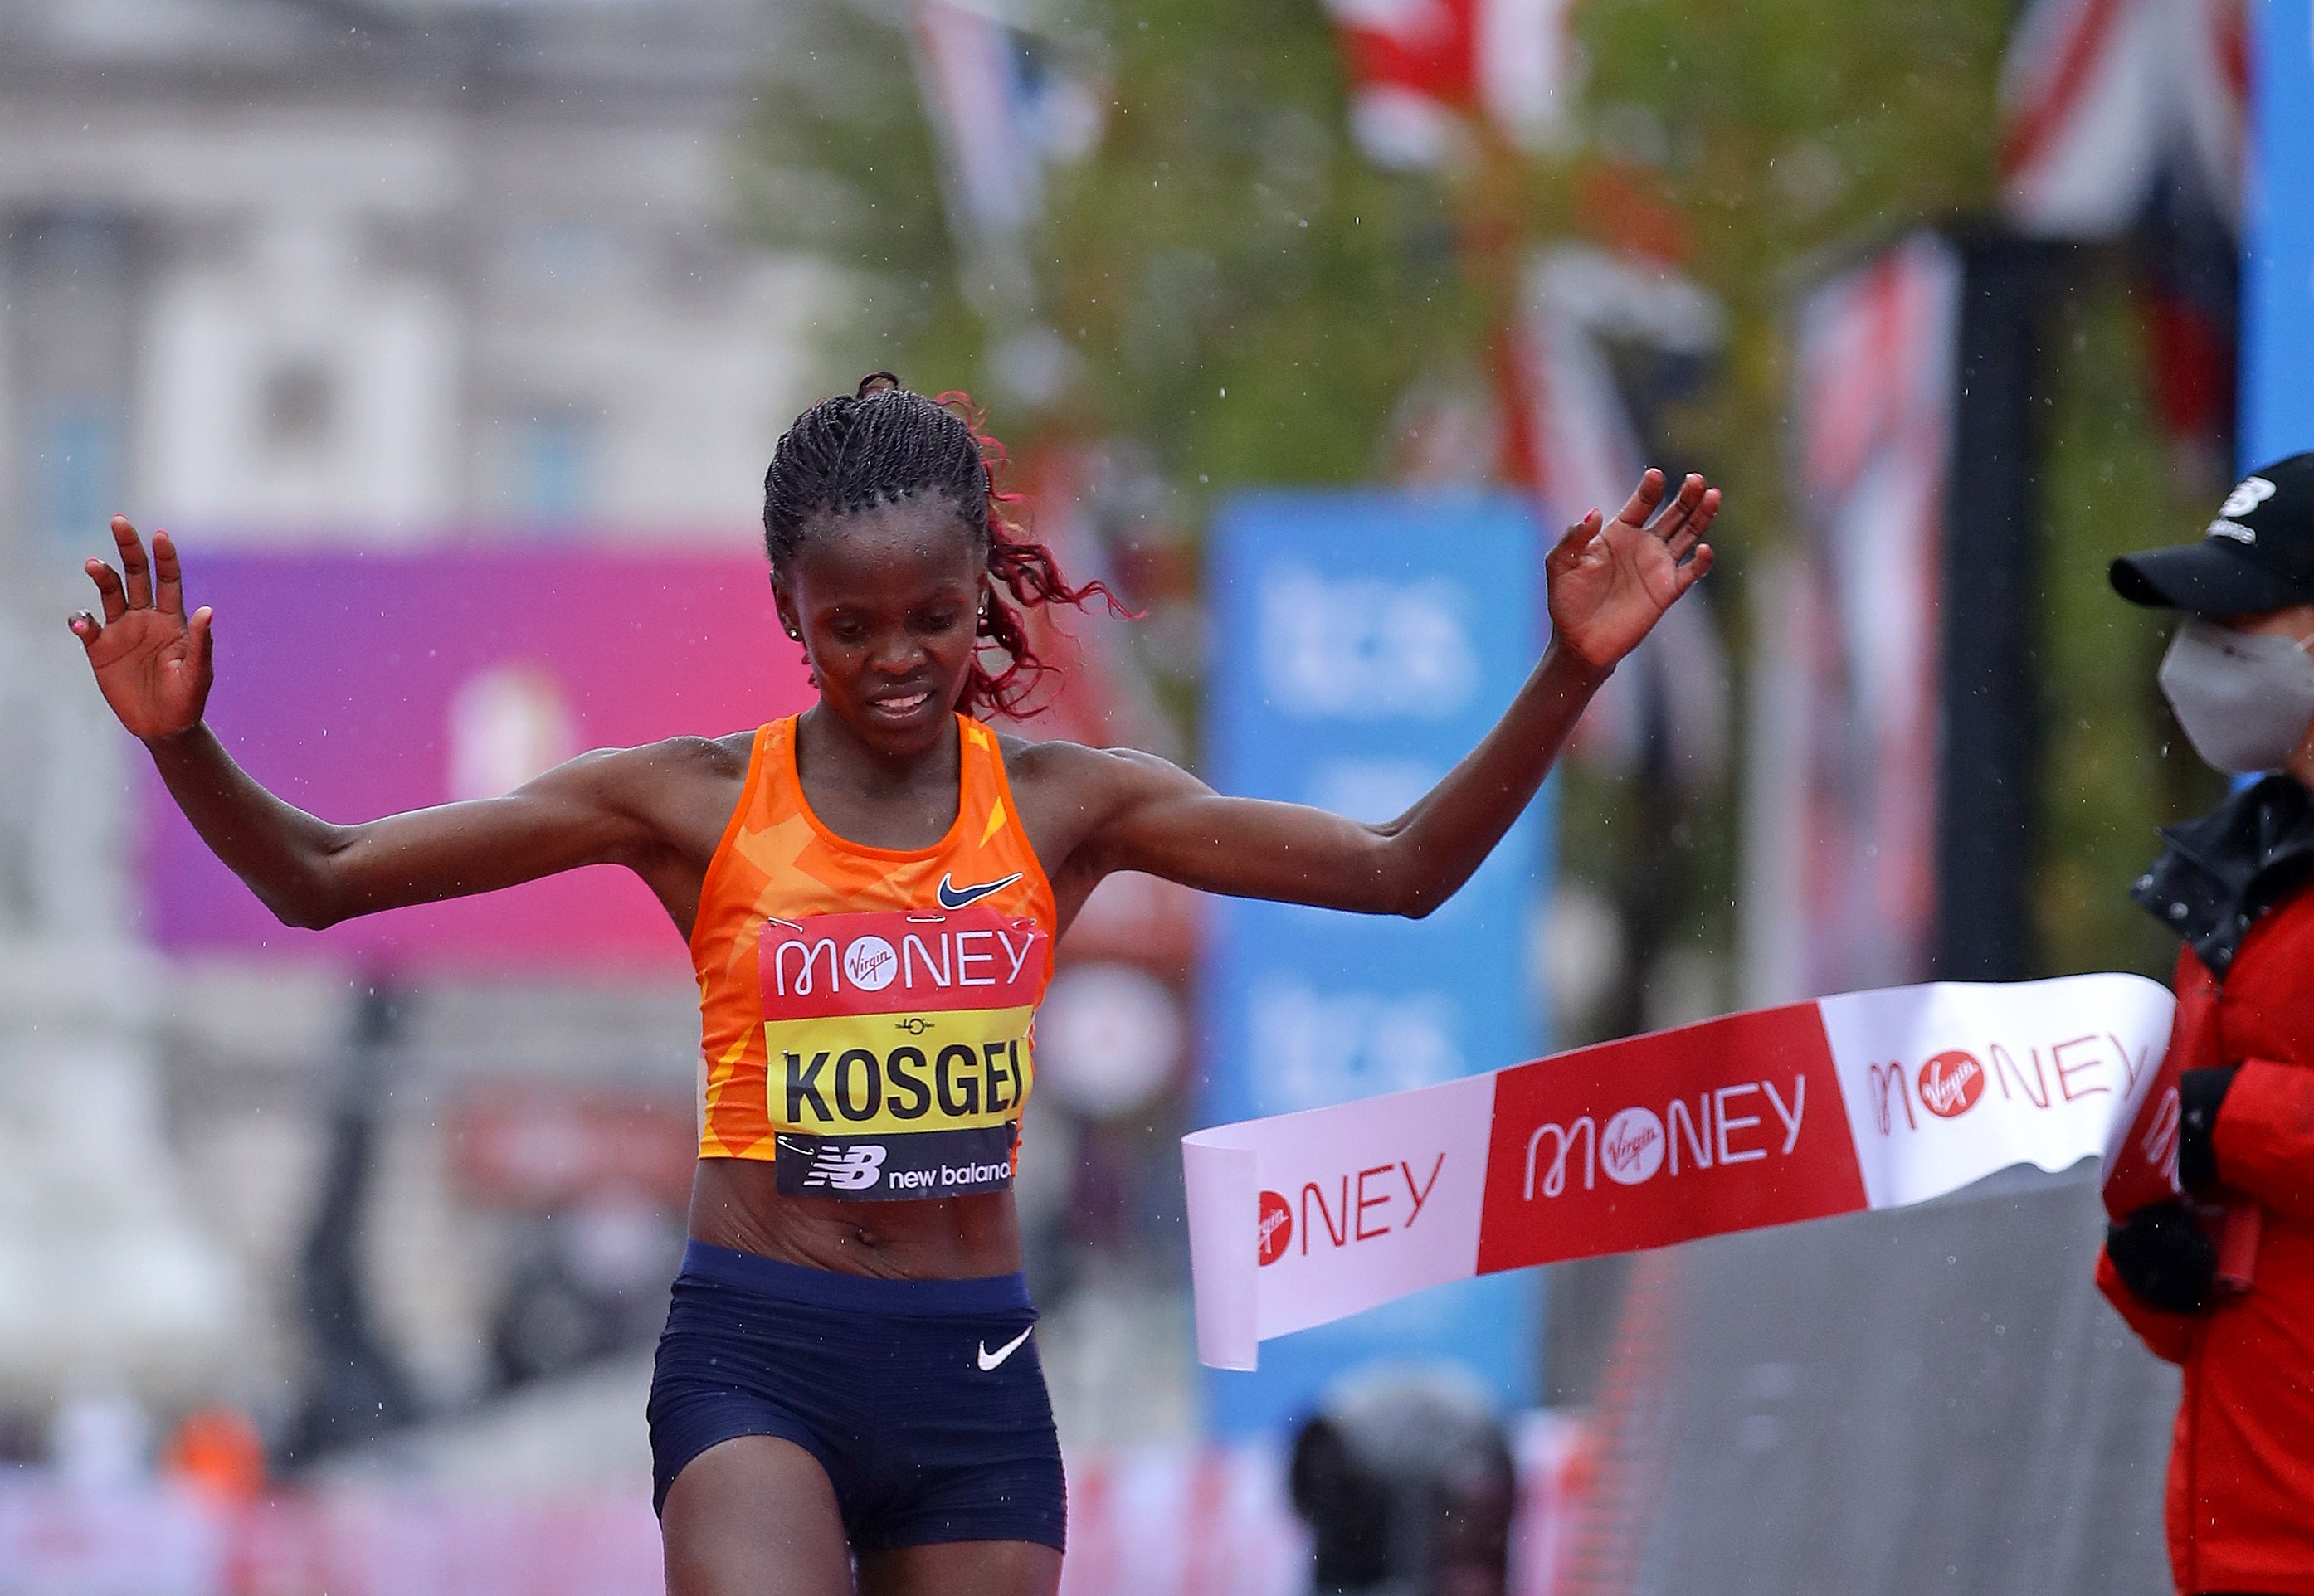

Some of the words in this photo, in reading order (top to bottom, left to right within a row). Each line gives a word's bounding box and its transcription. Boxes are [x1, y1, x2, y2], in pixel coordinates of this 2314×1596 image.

[775, 930, 1035, 996] MONEY
[849, 942, 892, 983] Virgin
[785, 1039, 1021, 1123] KOSGEI
[1921, 1058, 1980, 1113] Virgin
[1523, 1073, 1806, 1202] MONEY
[1608, 1118, 1659, 1172] Virgin
[889, 1169, 937, 1190] new
[941, 1161, 1011, 1186] balanc
